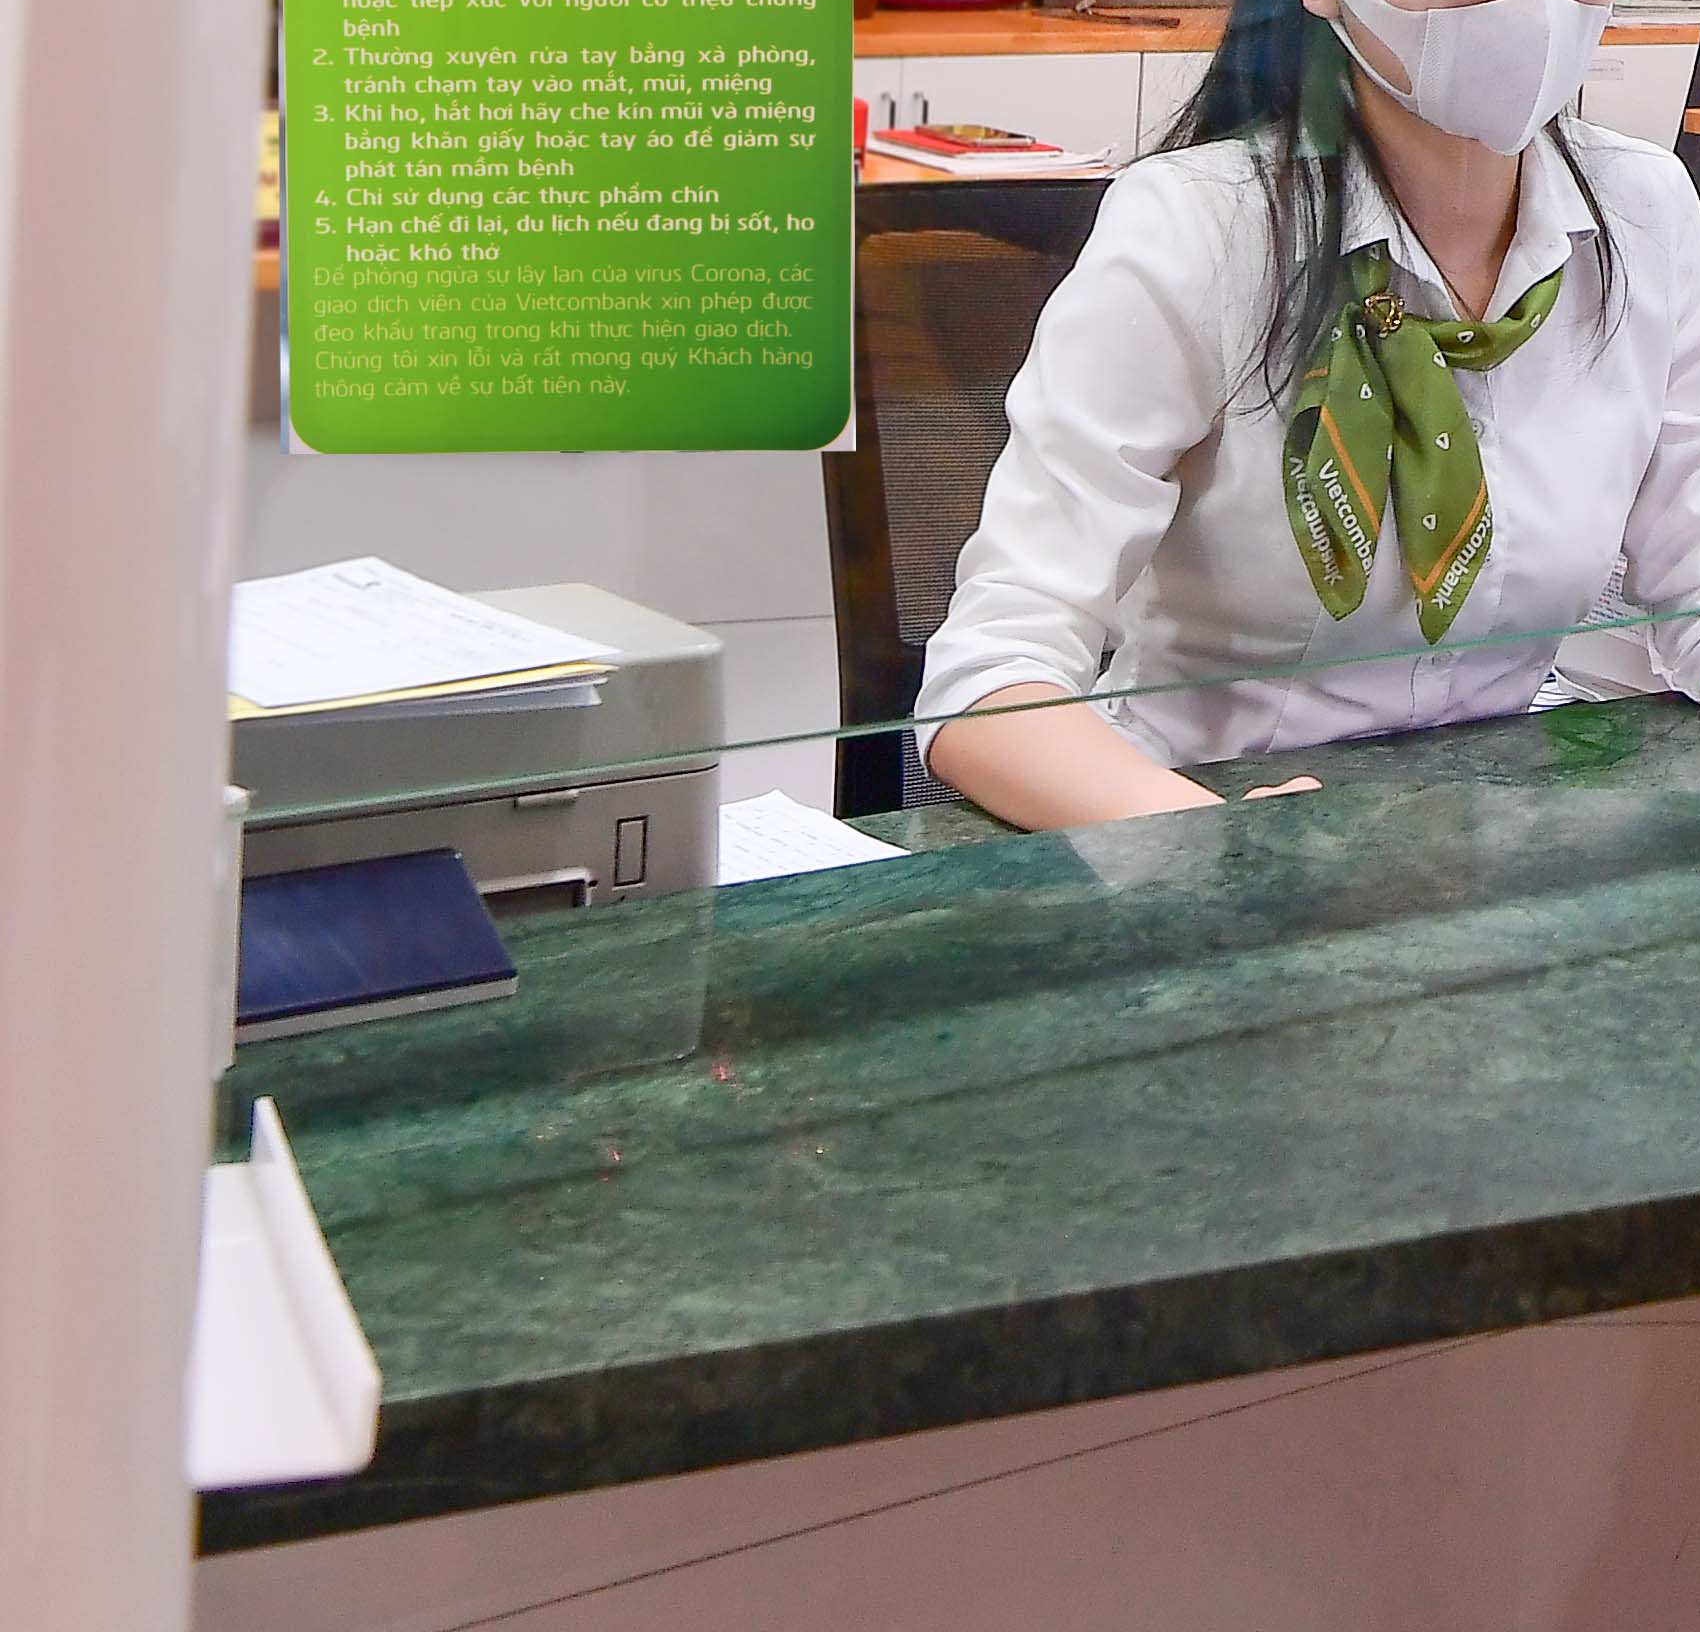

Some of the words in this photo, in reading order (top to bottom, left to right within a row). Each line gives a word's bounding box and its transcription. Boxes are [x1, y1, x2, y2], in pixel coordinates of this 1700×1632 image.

[342, 17, 401, 41] bệnh
[311, 47, 335, 66] 2.
[343, 46, 434, 70] Thường
[446, 45, 518, 70] xuyên
[529, 45, 569, 66] rửa
[579, 46, 618, 69] tay
[629, 40, 686, 69] bằng
[697, 44, 726, 65] xà
[737, 43, 816, 68] phòng,
[343, 74, 407, 95] tránh
[414, 74, 478, 98] chạm
[485, 75, 524, 98] tay
[530, 73, 574, 94] vào
[581, 68, 635, 96] mắt,
[642, 72, 693, 96] mũi,
[701, 71, 773, 96] miệng
[313, 103, 336, 123] 3.
[344, 102, 383, 123] Khi
[389, 102, 427, 126] ho,
[433, 98, 472, 122] hắt
[478, 101, 514, 122] hơi
[520, 101, 563, 125] hãy
[569, 101, 611, 122] che
[616, 100, 654, 121] kín
[660, 100, 704, 121] mũi
[710, 100, 739, 121] và
[744, 99, 816, 125] miệng
[344, 127, 401, 155] bằng
[410, 130, 469, 151] khăn
[477, 127, 526, 154] giấy
[534, 129, 590, 153] hoặc
[599, 130, 638, 153] tay
[645, 128, 675, 149] áo
[683, 124, 715, 149] để
[722, 128, 780, 152] giảm
[788, 132, 817, 152] sự
[344, 159, 397, 183] phát
[404, 158, 443, 179] tán
[450, 155, 510, 178] mầm
[517, 156, 575, 181] bệnh
[314, 188, 337, 208] 4.
[345, 186, 383, 207] Chỉ
[391, 187, 420, 207] sử
[426, 185, 485, 210] dụng
[492, 185, 531, 206] các
[537, 185, 591, 209] thực
[598, 181, 664, 209] phẩm
[670, 184, 720, 205] chín
[314, 216, 337, 236] 5.
[345, 215, 394, 239] Hạn
[400, 211, 443, 235] chế
[447, 214, 470, 234] đi
[476, 213, 510, 237] lại,
[515, 213, 545, 234] du
[550, 212, 591, 237] lịch
[596, 209, 640, 233] nếu
[645, 212, 704, 237] đang
[709, 212, 731, 235] bị
[736, 209, 779, 235] sốt,
[785, 212, 816, 232] ho
[345, 243, 401, 266] hoặc
[408, 242, 454, 263] khó
[459, 241, 501, 262] thở
